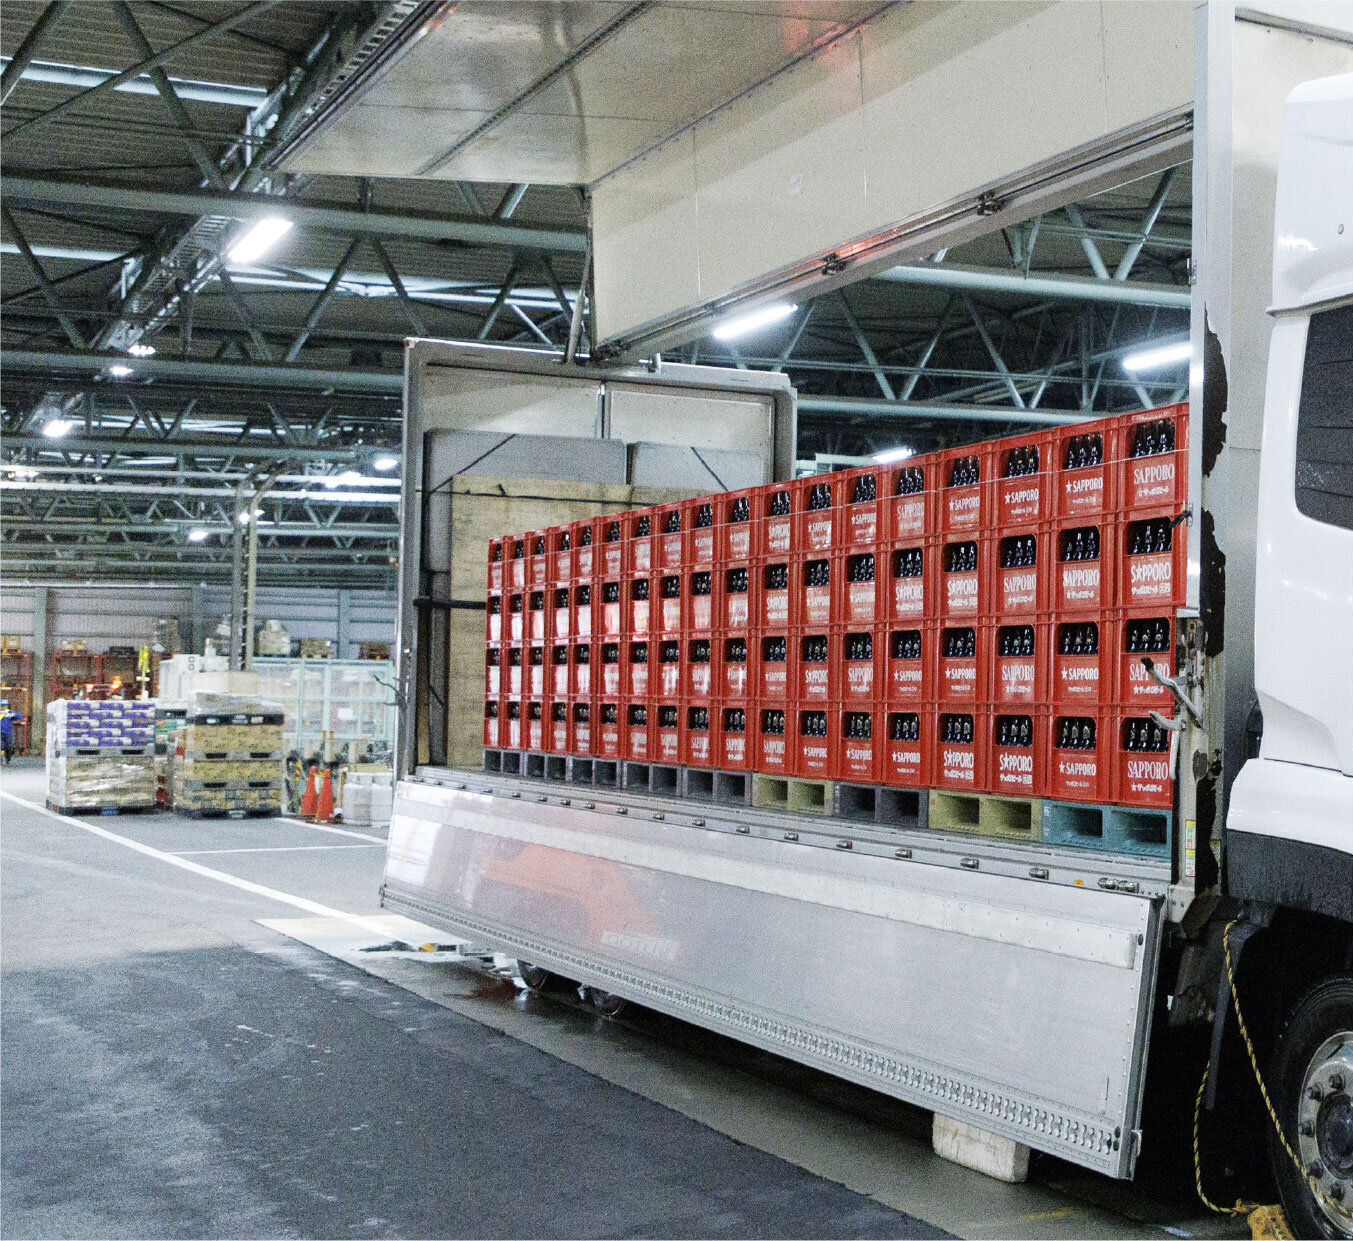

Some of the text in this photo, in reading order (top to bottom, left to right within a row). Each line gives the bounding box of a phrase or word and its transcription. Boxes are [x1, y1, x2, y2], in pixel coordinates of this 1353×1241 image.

[1133, 463, 1175, 485] SAPPORO
[1072, 477, 1103, 493] SAPPORO
[955, 496, 980, 510] SAPPORO
[1011, 488, 1039, 504] SAPPORO
[1004, 573, 1036, 593] SAPPORO
[1063, 569, 1100, 587] SAPPORO
[951, 668, 976, 680] SAPPORO
[1002, 664, 1035, 681] SAPPORO
[1069, 667, 1099, 681] SAPPORO
[1066, 761, 1097, 777] SAPPORO
[1128, 760, 1169, 781] SAPPORO
